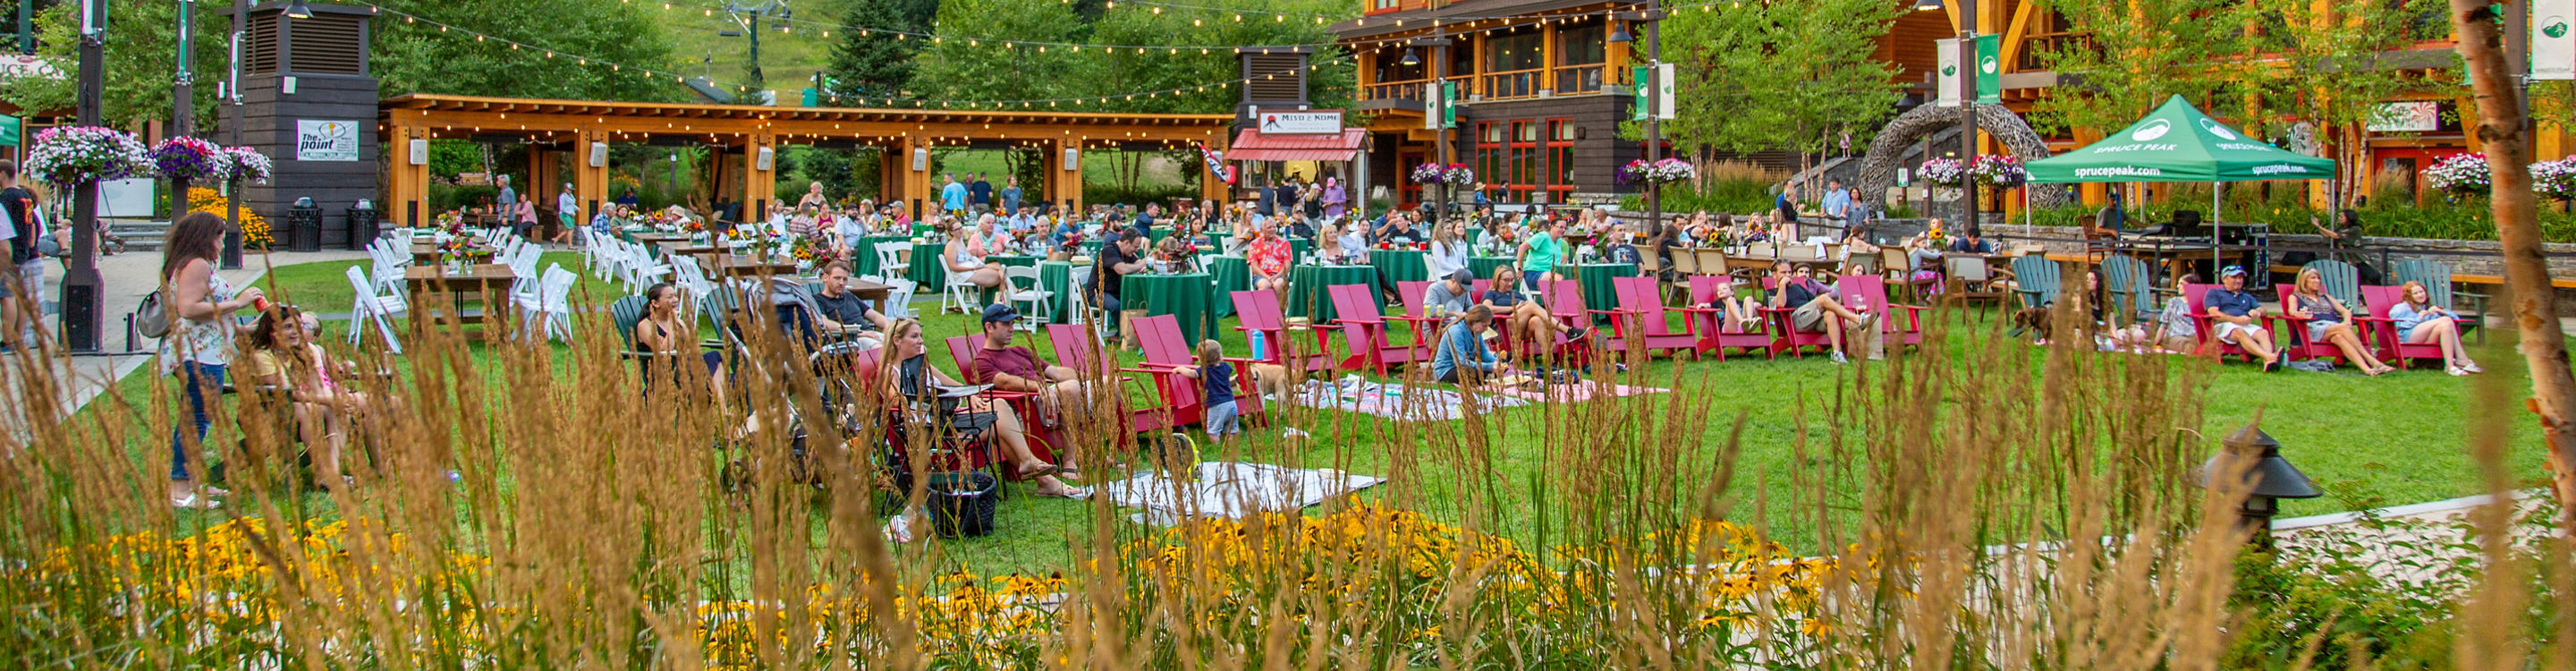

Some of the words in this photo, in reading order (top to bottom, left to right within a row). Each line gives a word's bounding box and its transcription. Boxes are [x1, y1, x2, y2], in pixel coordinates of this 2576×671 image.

[302, 133, 318, 141] The
[300, 139, 334, 152] point
[2094, 144, 2142, 154] SPRUCE
[2143, 143, 2177, 151] PEAK
[2074, 165, 2161, 178] sprucepeak.com
[2252, 163, 2307, 176] sprucepeak.com
